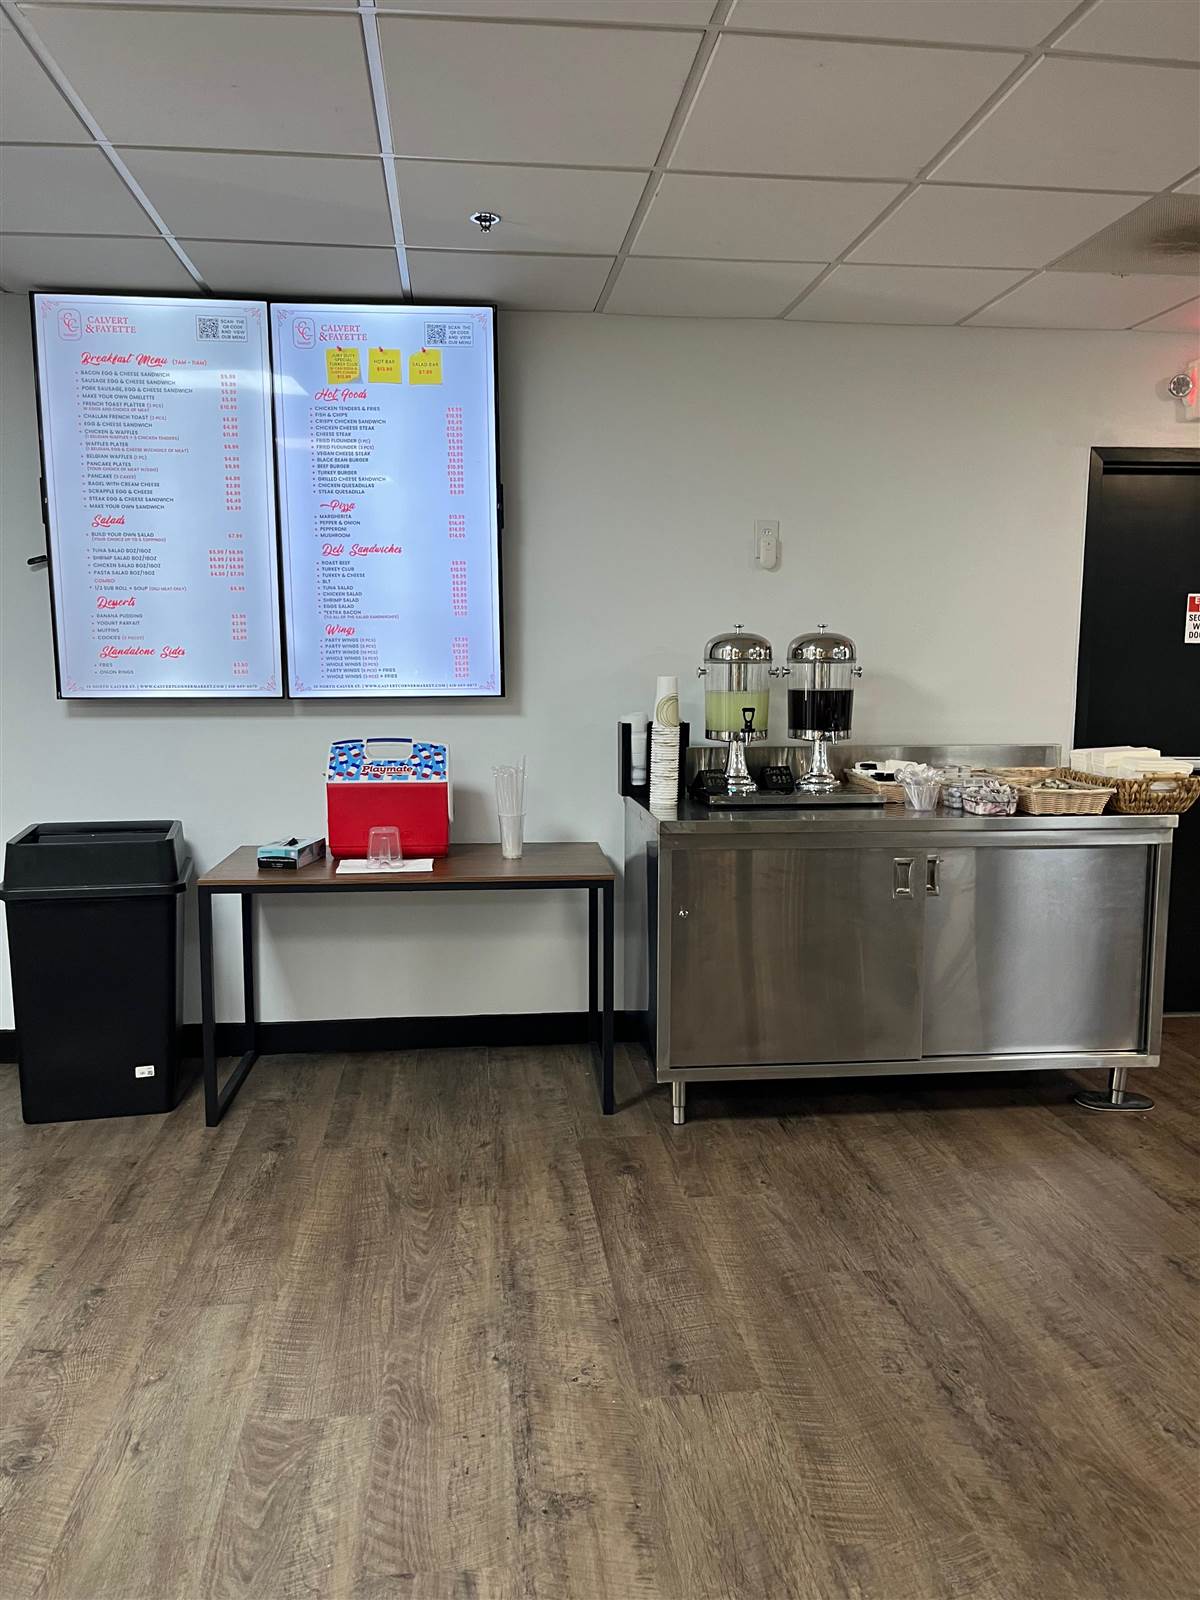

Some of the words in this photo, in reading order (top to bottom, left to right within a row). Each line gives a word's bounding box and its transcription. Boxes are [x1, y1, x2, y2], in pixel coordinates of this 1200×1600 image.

[88, 316, 128, 325] CALVERT
[80, 352, 134, 365] Breakfast
[136, 354, 167, 367] Menu
[315, 388, 340, 401] Hot
[320, 499, 355, 512] Pizza
[92, 514, 125, 527] Salads
[322, 543, 344, 556] Deli
[349, 544, 402, 556] Sandwiches
[97, 596, 136, 608] Desserts
[326, 624, 355, 636] Wings
[100, 646, 155, 658] Standalone
[160, 646, 185, 658] Sides
[362, 766, 413, 774] Playmate
